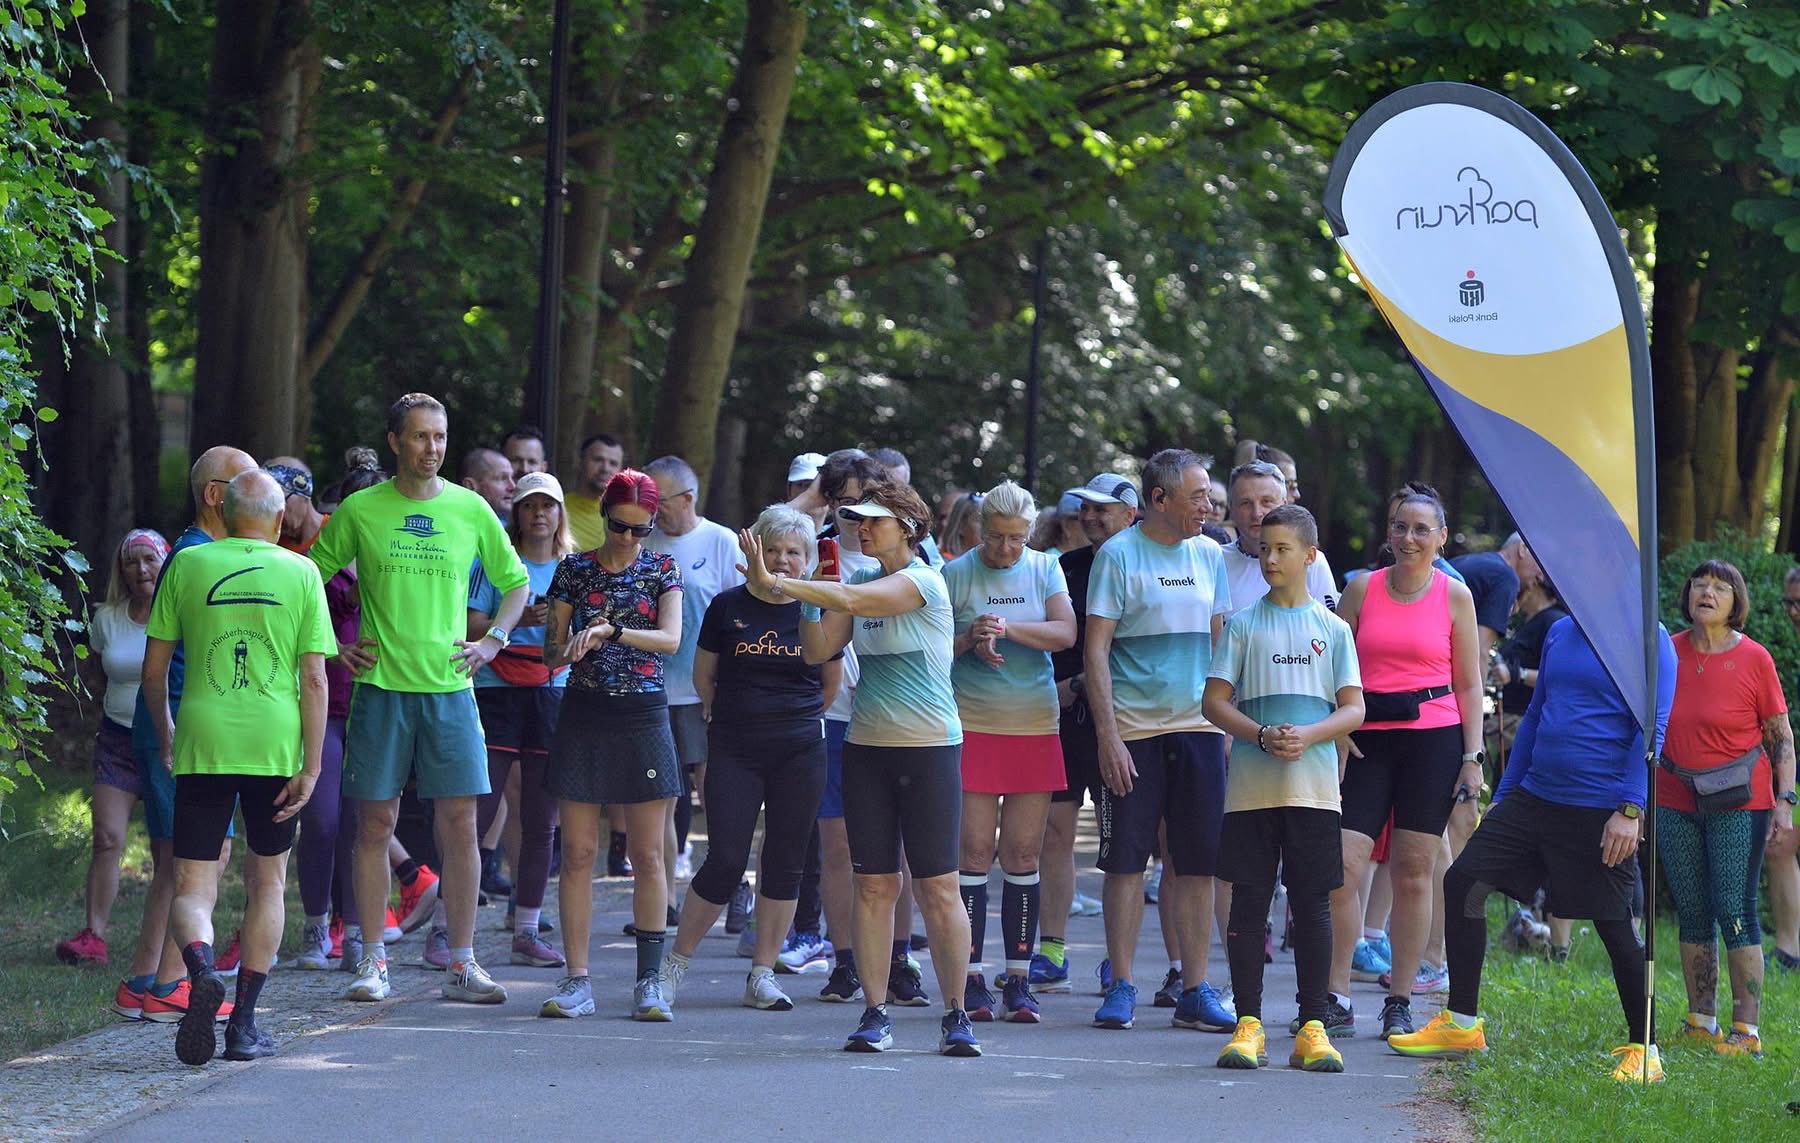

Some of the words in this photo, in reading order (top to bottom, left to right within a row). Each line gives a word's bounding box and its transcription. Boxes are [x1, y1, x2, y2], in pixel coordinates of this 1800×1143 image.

[376, 565, 457, 581] SEETELHOTELS
[1157, 576, 1196, 587] Tomek
[986, 596, 1026, 606] Joanna
[1272, 653, 1312, 666] Gabriel
